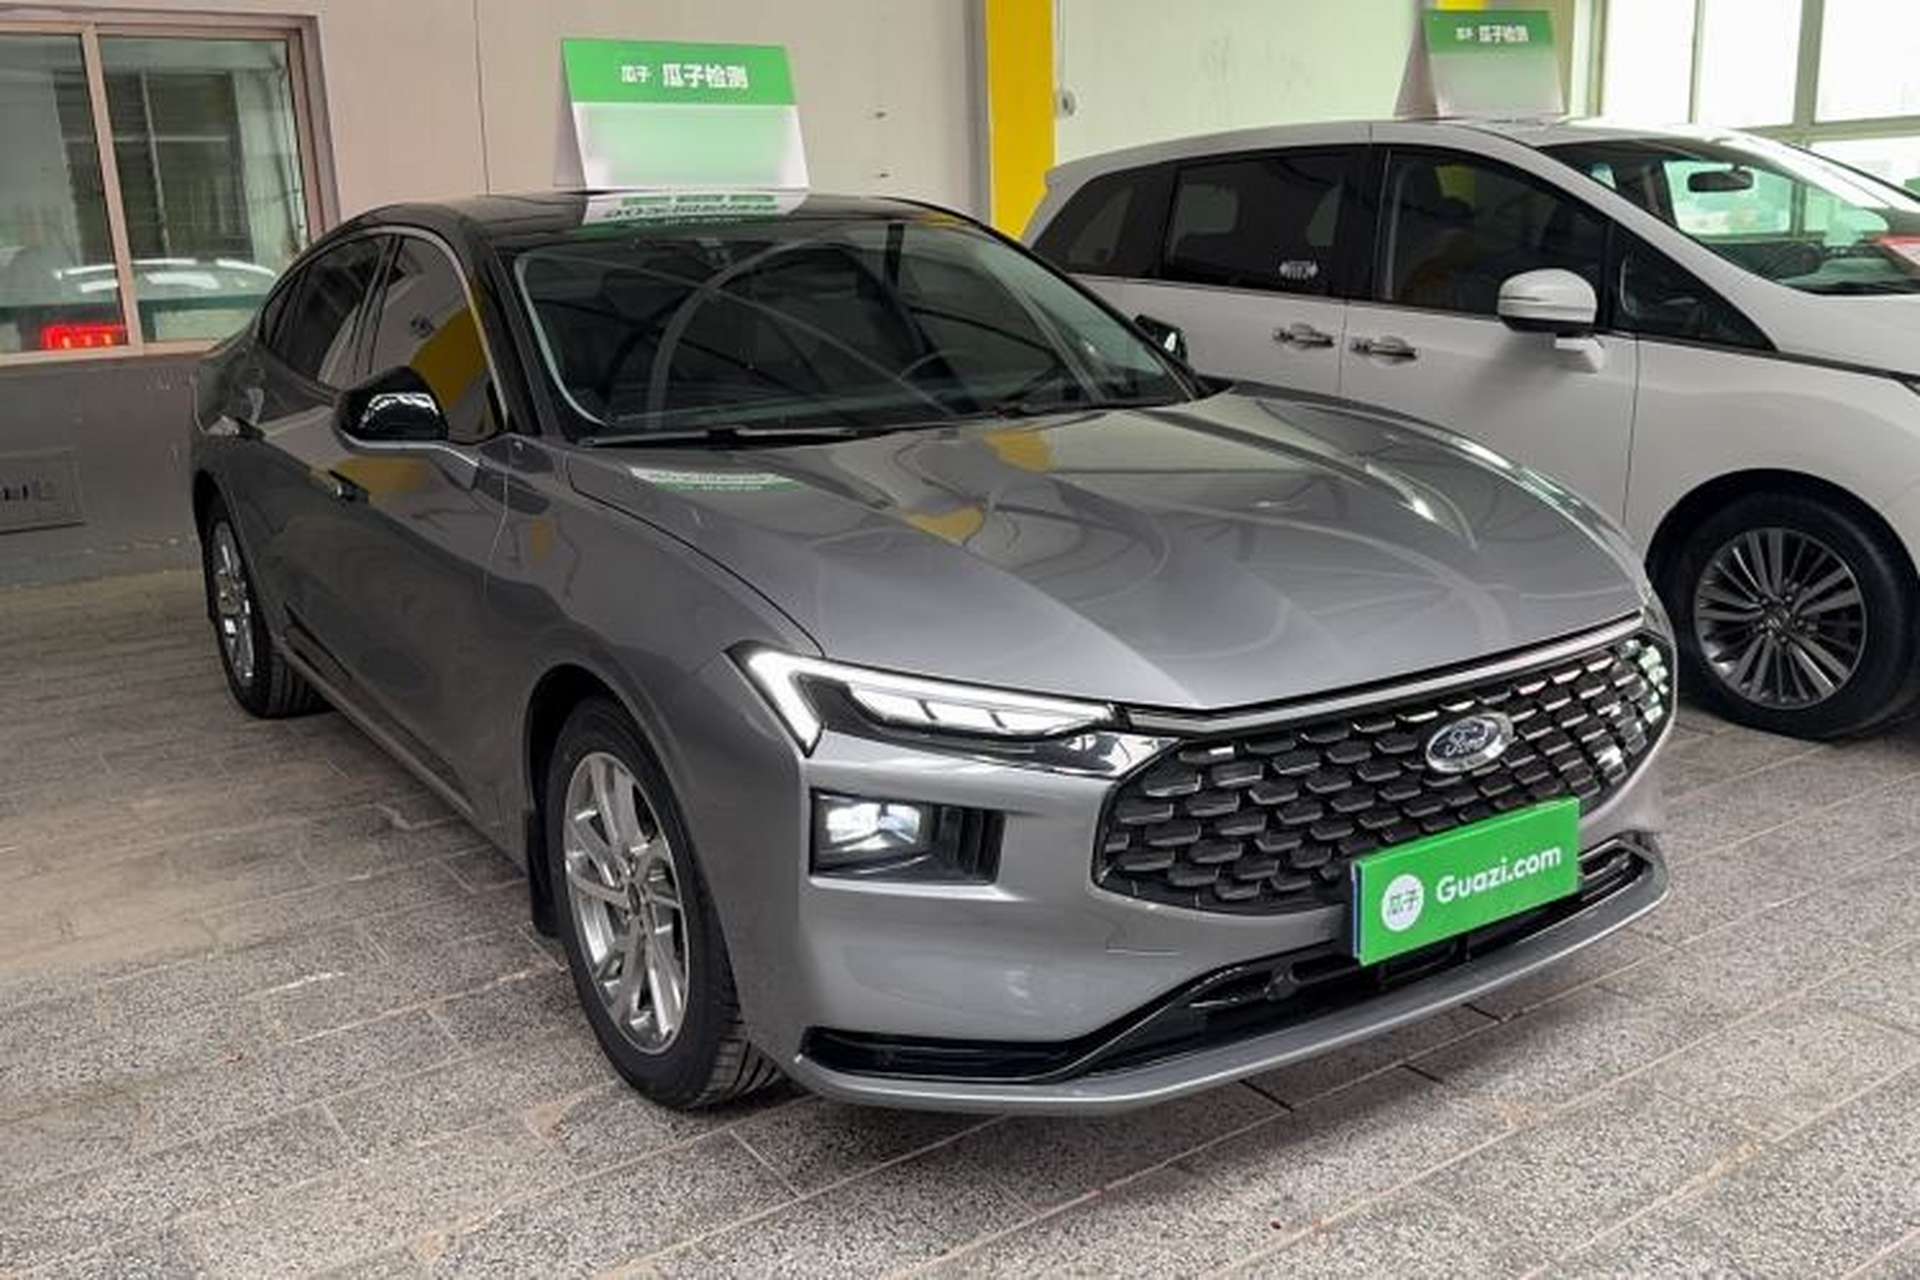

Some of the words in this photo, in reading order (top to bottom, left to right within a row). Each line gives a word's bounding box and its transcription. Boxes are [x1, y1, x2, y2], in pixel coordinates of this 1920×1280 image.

[662, 63, 749, 89] 瓜子检测
[1436, 846, 1562, 903] Guazi.com
